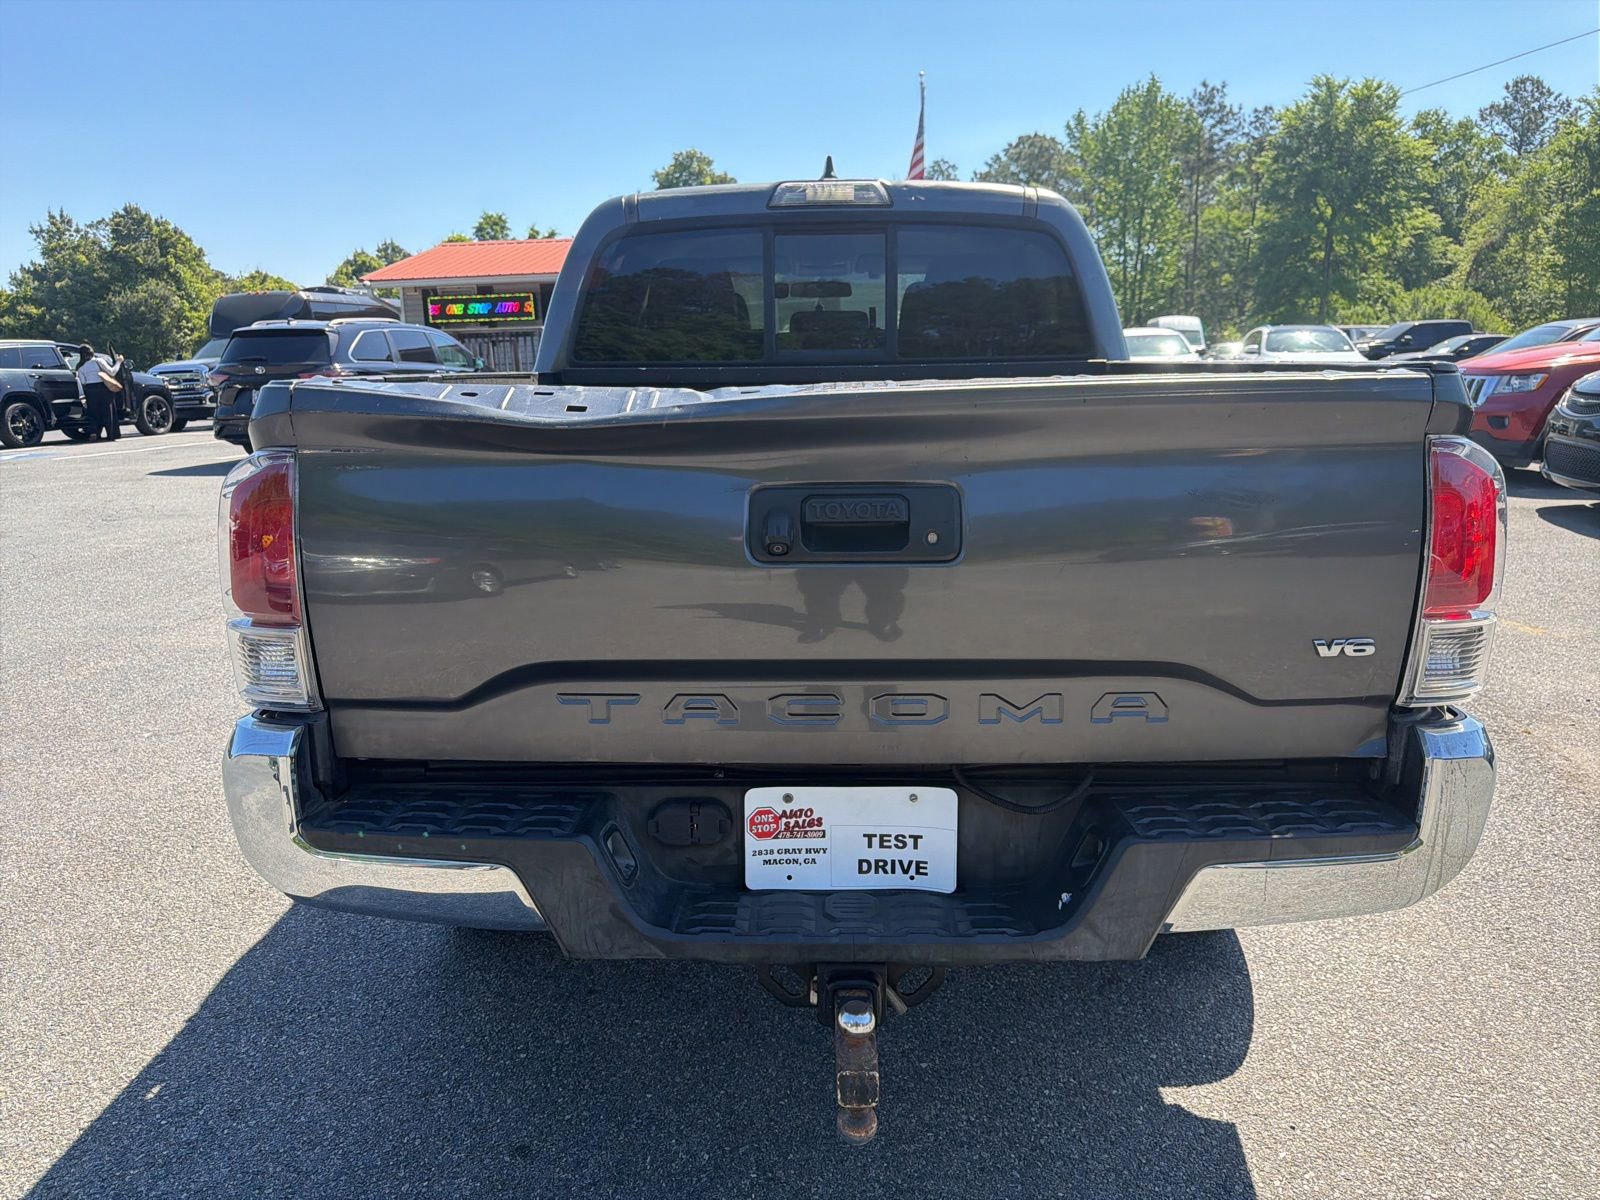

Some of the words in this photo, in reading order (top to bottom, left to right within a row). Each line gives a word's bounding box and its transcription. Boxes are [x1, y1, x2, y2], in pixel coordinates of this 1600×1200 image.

[446, 303, 465, 316] ONE
[467, 302, 493, 315] STOP
[495, 301, 520, 313] AUTO
[811, 502, 900, 520] TOYOTA
[1312, 638, 1376, 657] V6
[556, 692, 1169, 726] TACOMA
[754, 814, 775, 823] ONE
[779, 808, 814, 820] AUTO
[752, 823, 777, 833] STOP
[784, 816, 823, 832] SALES
[778, 830, 824, 839] 478-741-8009
[863, 833, 924, 850] TEST
[752, 849, 775, 857] 2838
[805, 847, 828, 855] HWY
[762, 858, 802, 866] MACON,
[858, 859, 929, 876] DRIVE
